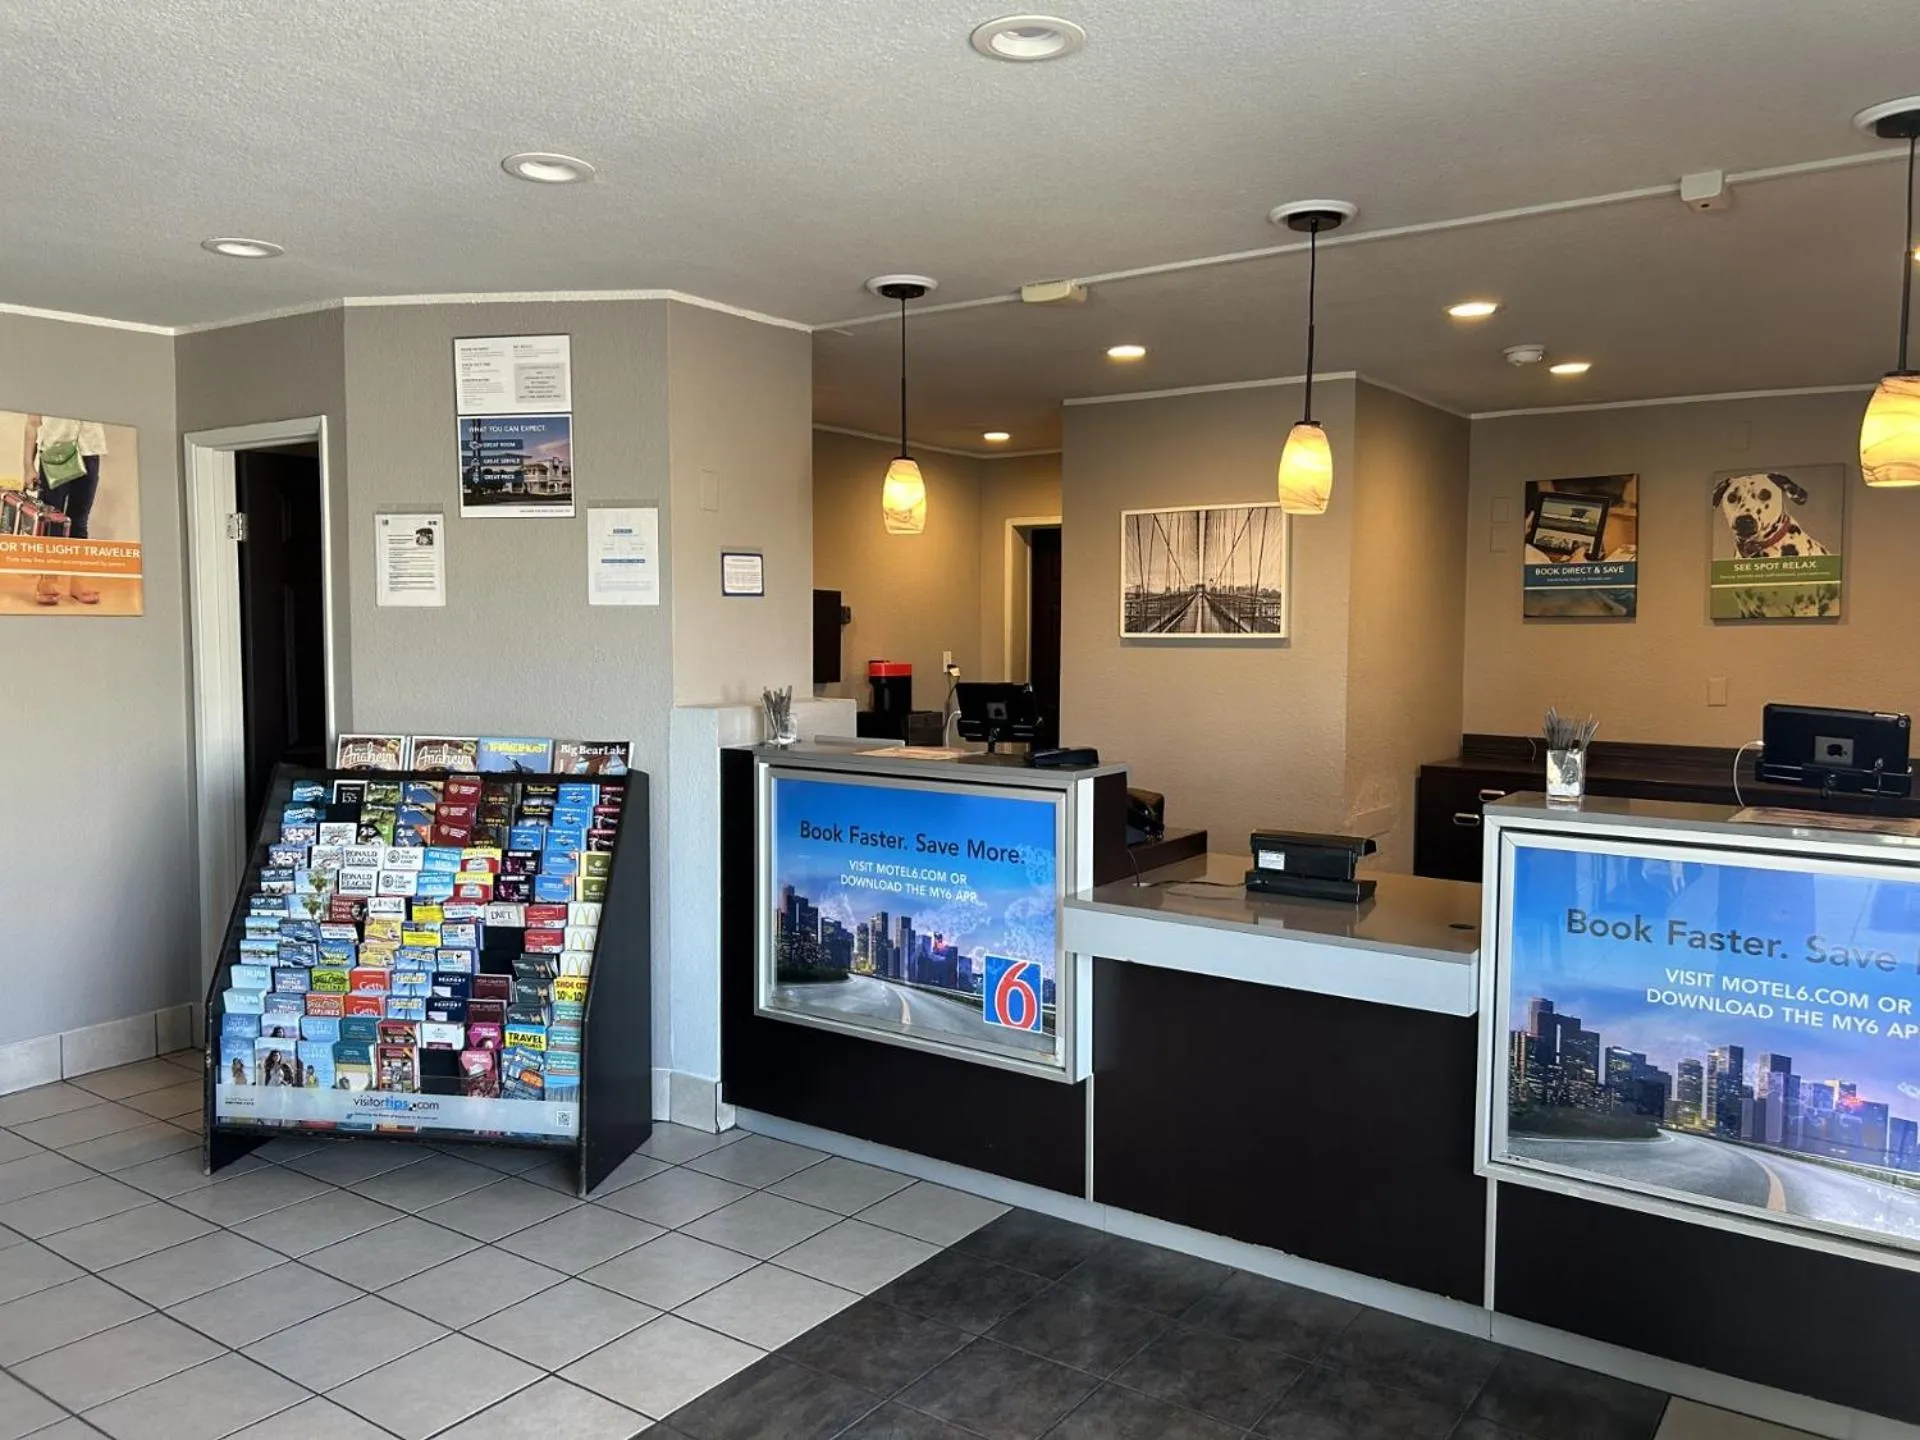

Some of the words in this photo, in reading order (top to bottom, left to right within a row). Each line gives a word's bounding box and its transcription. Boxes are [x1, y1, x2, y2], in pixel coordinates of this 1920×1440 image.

[0, 541, 17, 552] OR
[20, 542, 44, 553] THE
[46, 544, 81, 556] LIGHT
[84, 546, 140, 558] TRAVELER
[1535, 567, 1560, 576] BOOK
[1562, 566, 1591, 575] DIRECT
[1603, 565, 1624, 574] SAVE
[1734, 563, 1752, 572] SEE
[1754, 562, 1779, 571] SPOT
[1782, 560, 1816, 569] RELAX
[341, 741, 396, 766] Anaheim
[416, 743, 472, 767] Anaheim
[561, 744, 578, 757] Big
[579, 745, 602, 756] Bear
[604, 746, 626, 756] Lake
[800, 820, 843, 844] Book
[850, 825, 908, 850] Faster.
[916, 832, 960, 858] Save
[967, 838, 1025, 864] More.
[849, 860, 874, 873] VISIT
[876, 864, 947, 882] MOTEL6.COM
[950, 873, 968, 886] OR
[840, 874, 902, 892] DOWNLOAD
[906, 884, 926, 896] THE
[928, 886, 952, 900] MY6
[1567, 908, 1652, 944] Book
[1668, 920, 1788, 960] Faster.
[1806, 935, 1897, 972] Save
[994, 960, 1038, 1030] 6
[1666, 968, 1714, 988] VISIT
[1722, 975, 1870, 1010] MOTEL6.COM
[1878, 996, 1912, 1015] OR
[1646, 988, 1774, 1020] DOWNLOAD
[1782, 1006, 1824, 1028] THE
[1832, 1014, 1879, 1035] MY6
[1886, 1022, 1920, 1040] AP
[508, 1032, 543, 1044] TRAVEL
